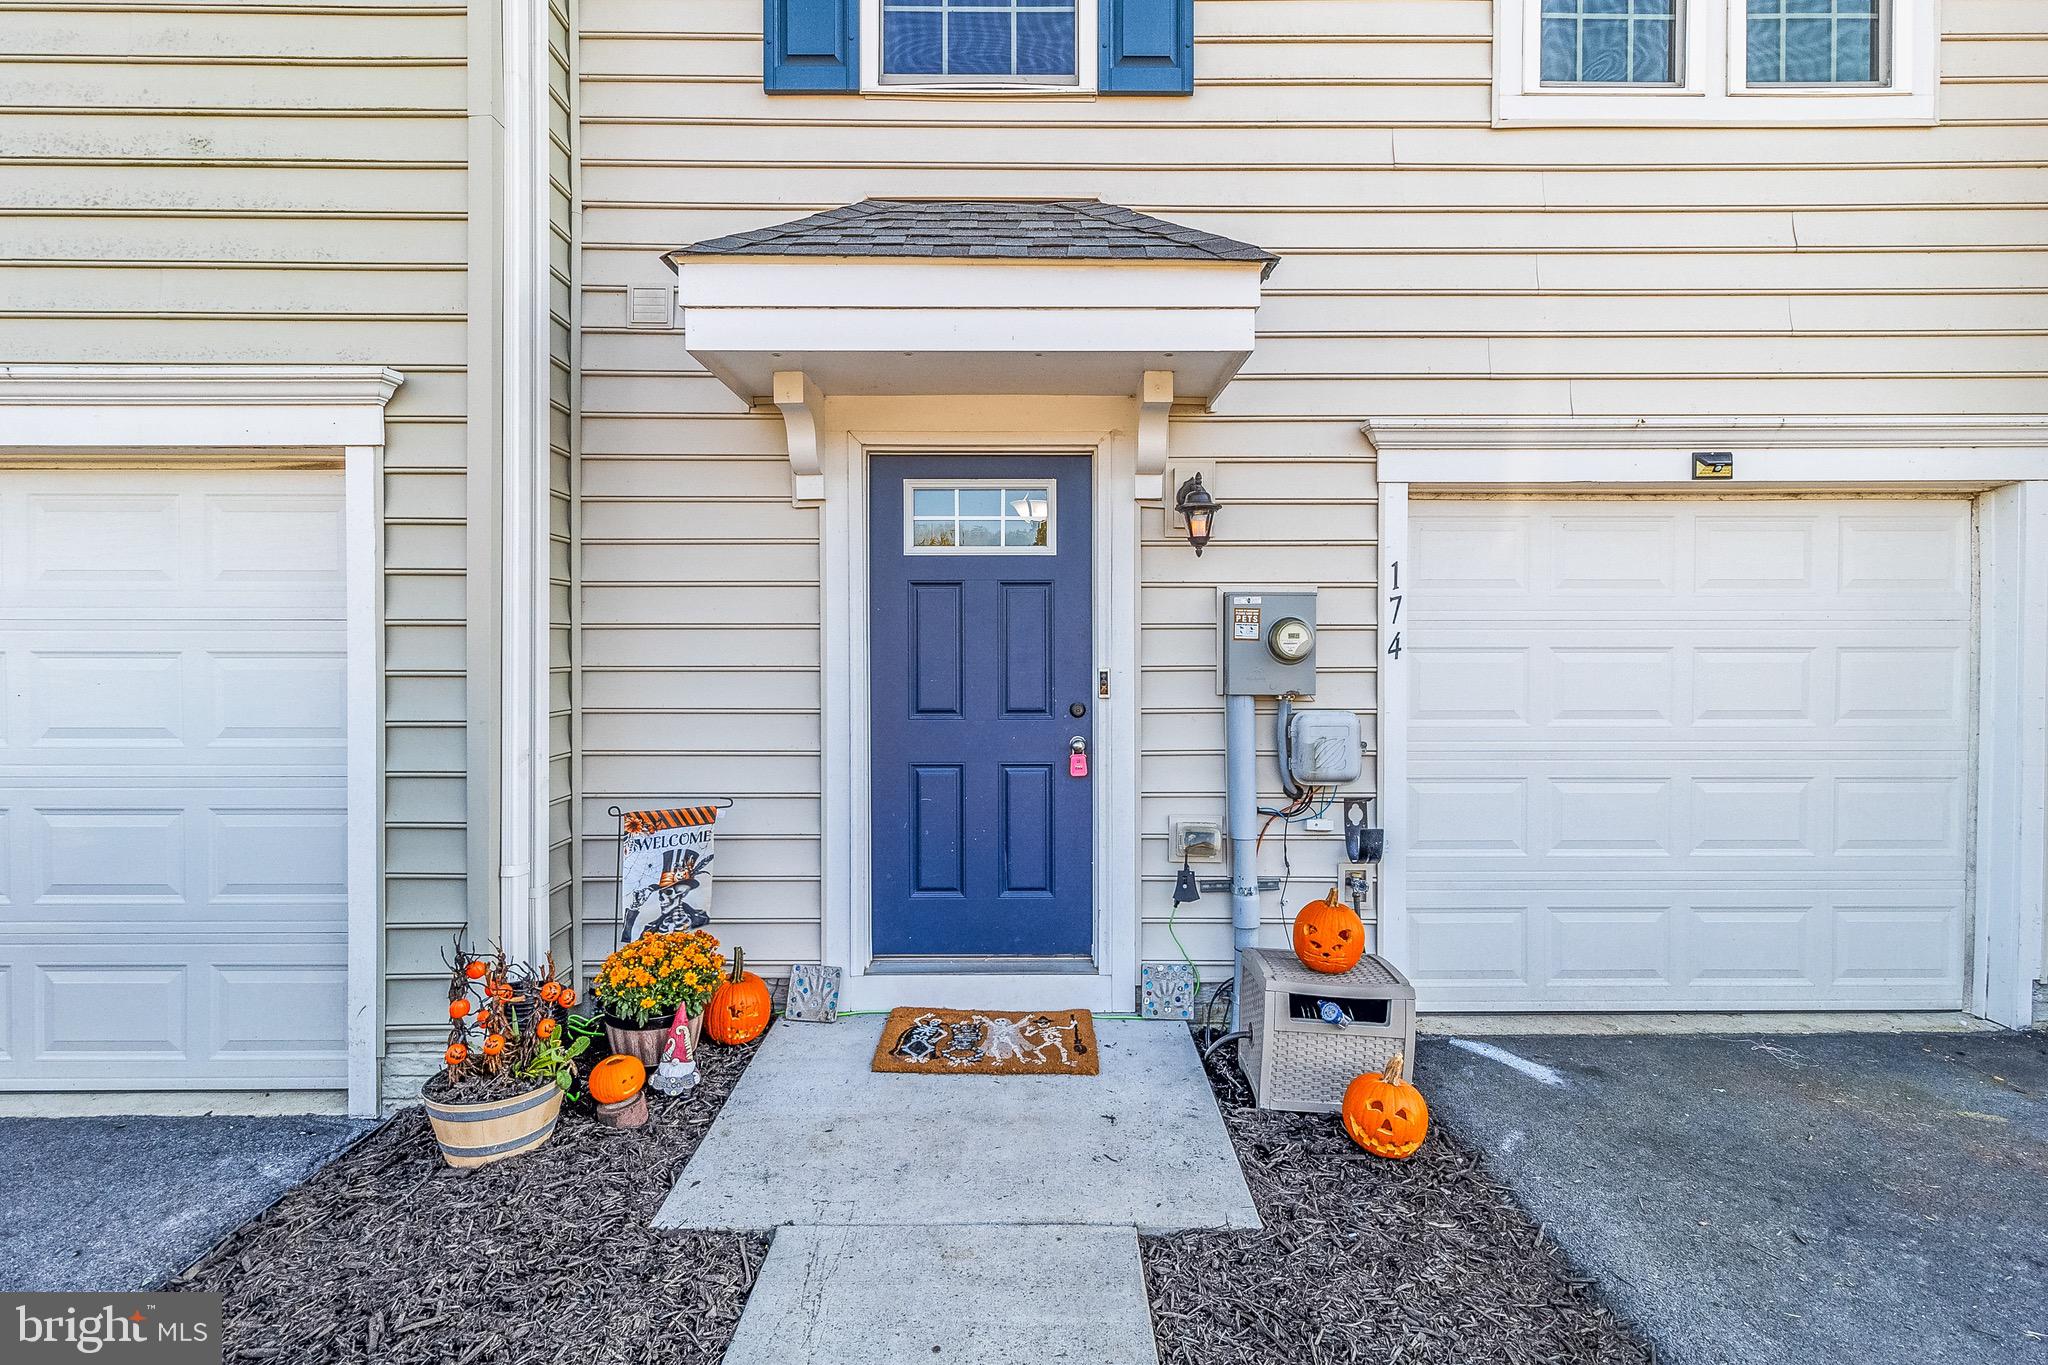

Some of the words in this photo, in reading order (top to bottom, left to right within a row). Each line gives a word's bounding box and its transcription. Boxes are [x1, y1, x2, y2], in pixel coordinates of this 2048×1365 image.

[1235, 615, 1259, 623] PETS
[1387, 560, 1403, 660] 174
[635, 829, 712, 851] WELCOME
